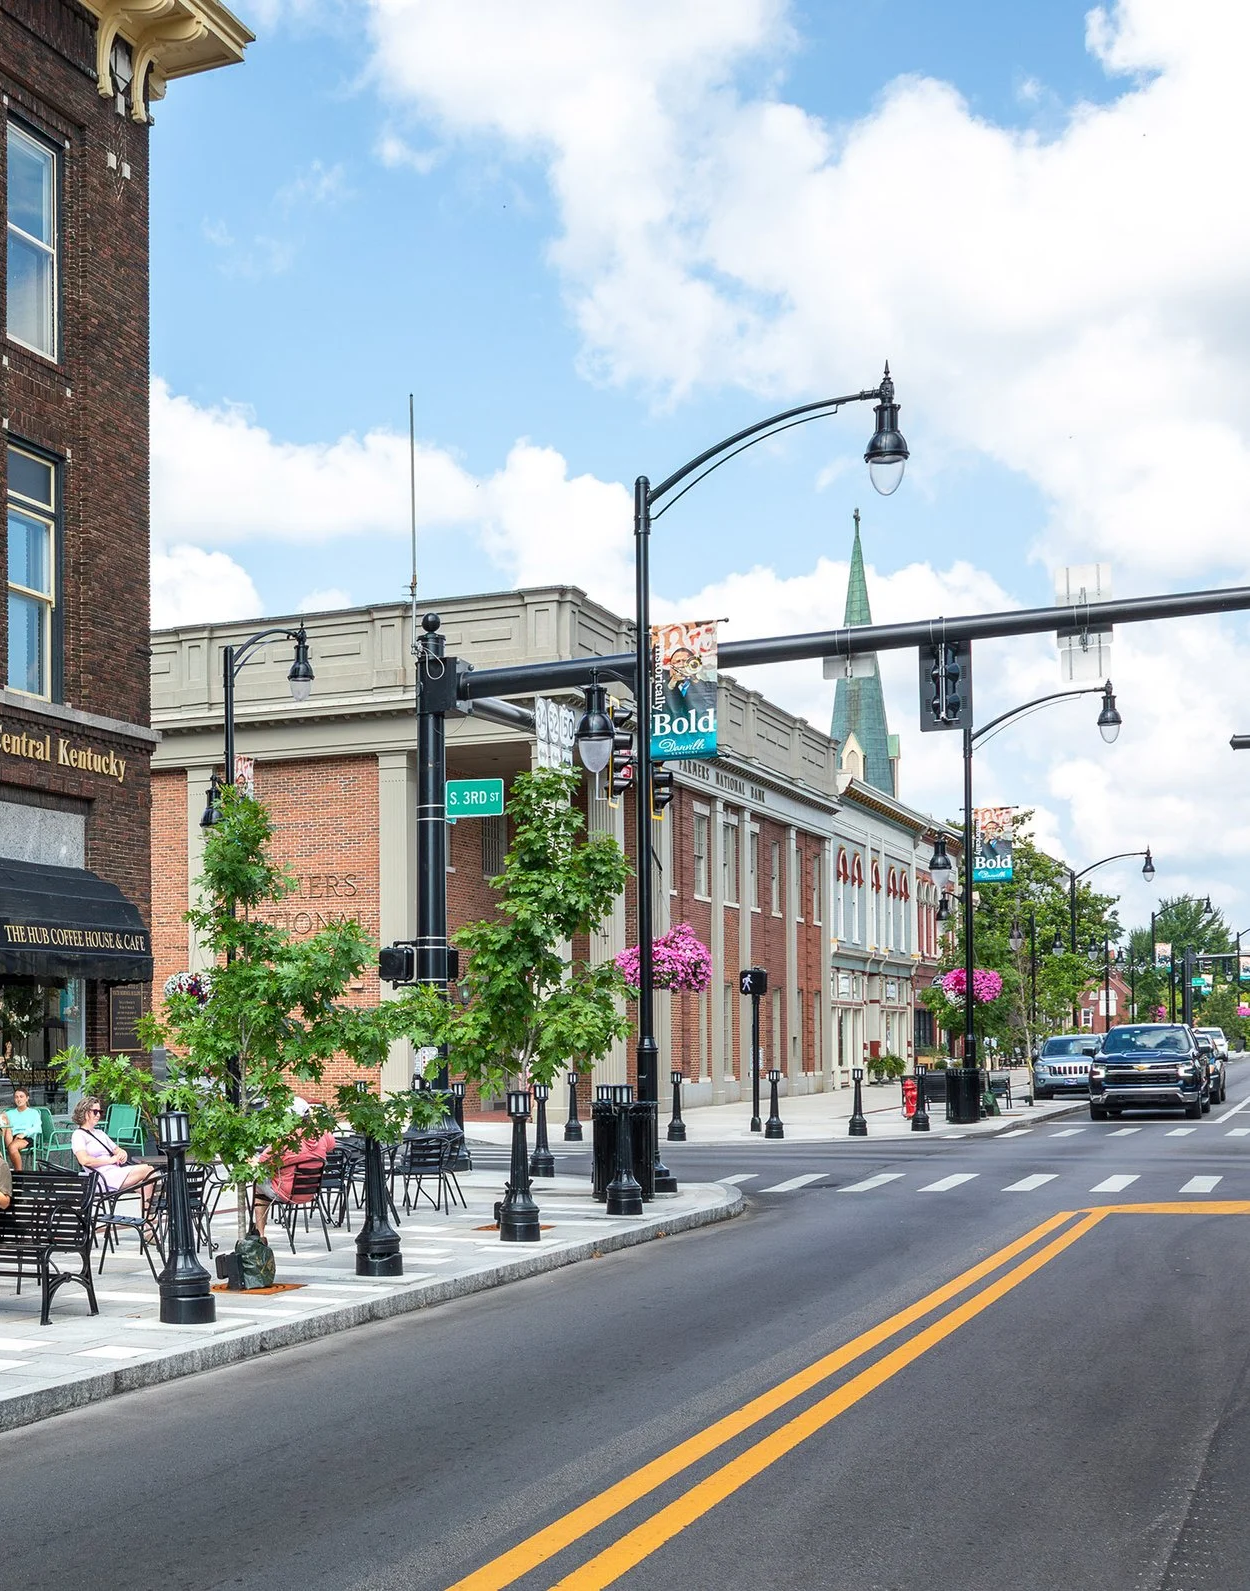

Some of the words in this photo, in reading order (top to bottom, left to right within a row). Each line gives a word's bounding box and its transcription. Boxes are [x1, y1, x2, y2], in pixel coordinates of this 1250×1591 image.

[653, 708, 717, 736] Bold
[658, 739, 706, 752] Danville
[57, 738, 126, 783] Kentucky
[679, 759, 710, 780] FARMERS
[715, 771, 746, 795] NATIONAL
[750, 786, 765, 803] BANK
[450, 792, 459, 805] S.
[463, 791, 487, 804] 3RD
[490, 792, 500, 801] ST
[974, 855, 1012, 869] Bold
[4, 925, 26, 943] THE
[26, 927, 50, 945] HUB
[50, 928, 85, 947] COFFEE
[85, 931, 115, 949] HOUSE
[115, 933, 123, 949] &
[123, 934, 146, 951] CAFE
